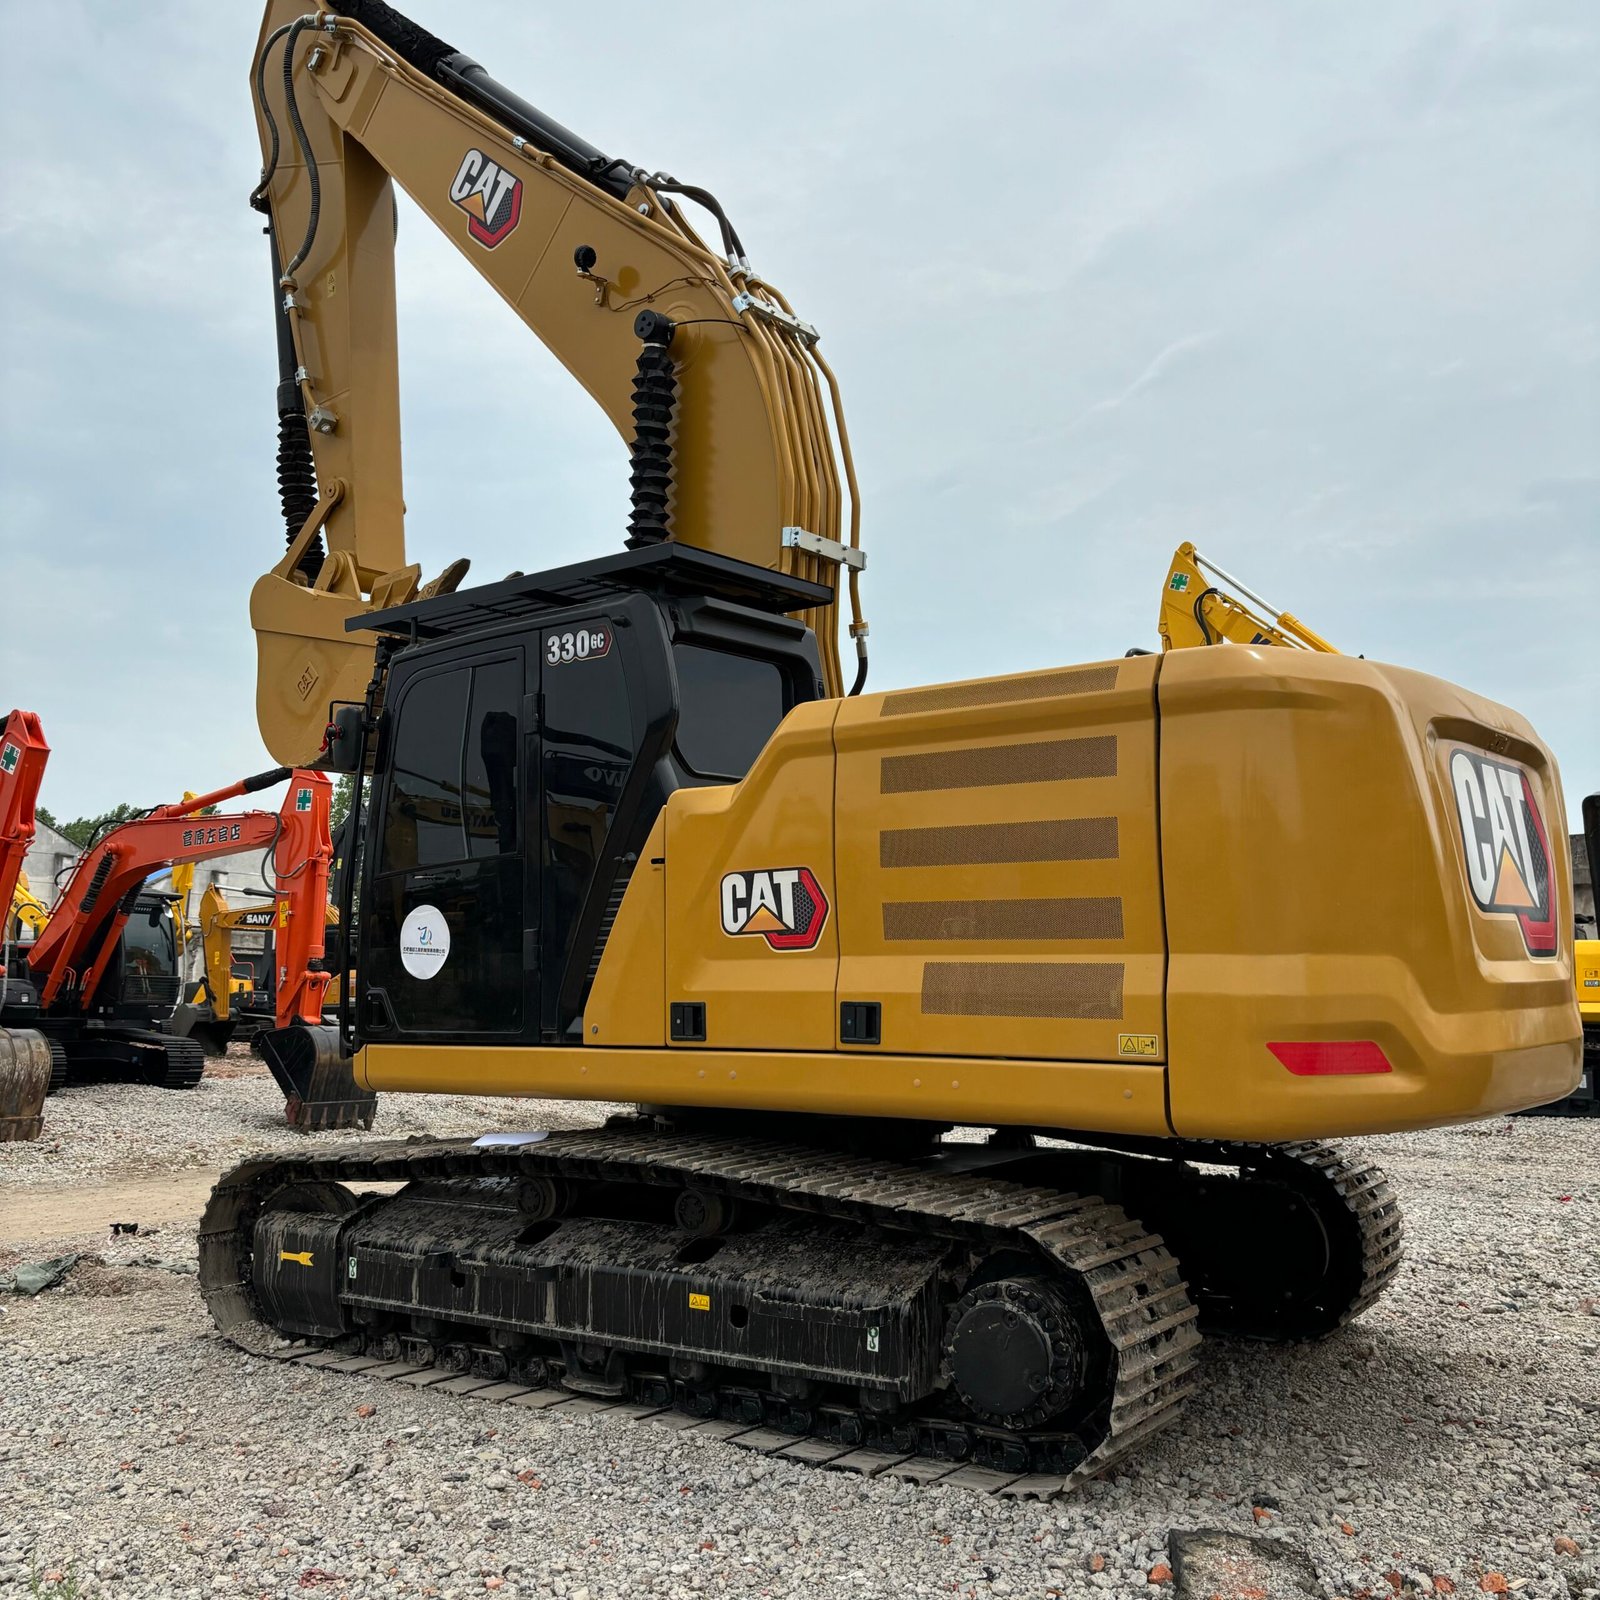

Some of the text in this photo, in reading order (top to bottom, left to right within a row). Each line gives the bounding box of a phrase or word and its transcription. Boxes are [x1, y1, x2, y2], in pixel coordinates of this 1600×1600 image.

[450, 149, 517, 227] CAT
[547, 629, 604, 663] 330 GC
[1452, 753, 1540, 908] CAT
[246, 914, 271, 924] SANY
[722, 870, 798, 933] CAT
